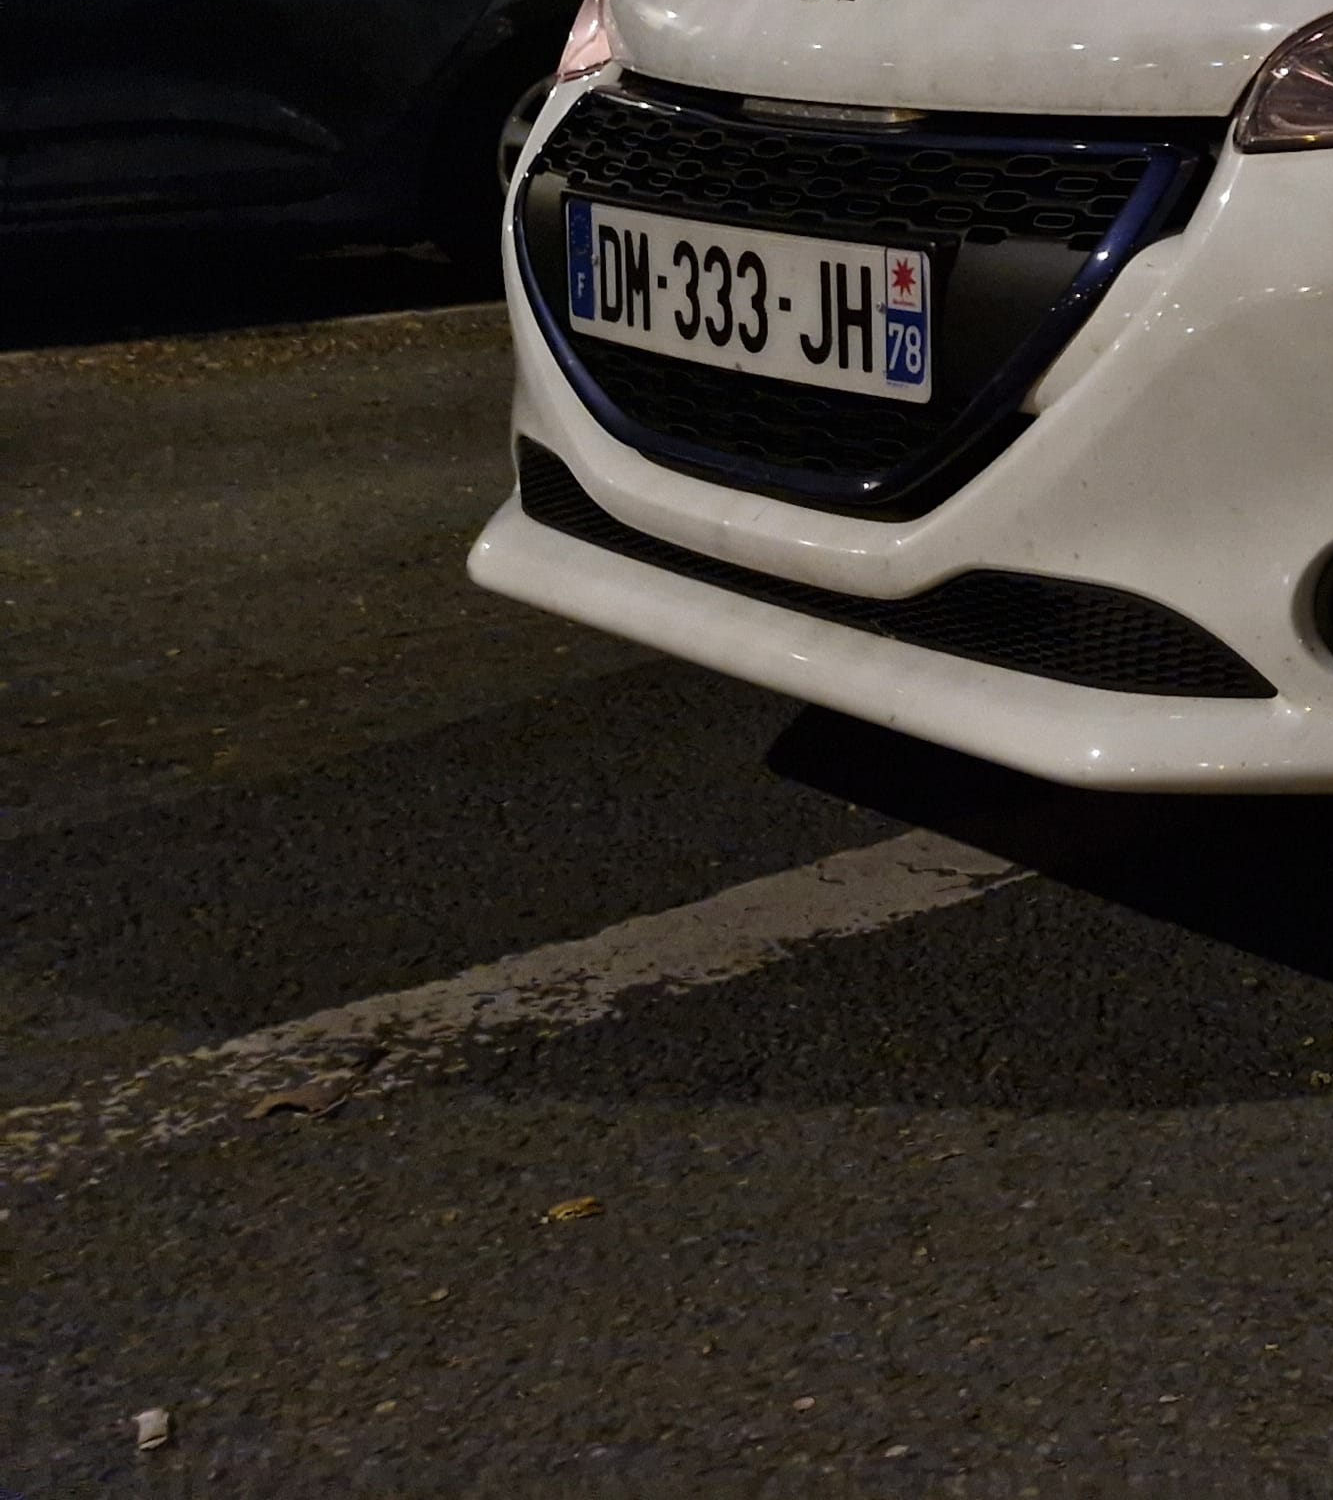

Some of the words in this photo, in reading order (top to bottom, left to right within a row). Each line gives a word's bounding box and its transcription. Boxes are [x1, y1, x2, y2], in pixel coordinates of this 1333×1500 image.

[578, 270, 587, 300] F
[598, 224, 873, 373] DM-333-JH
[888, 322, 922, 375] 78
